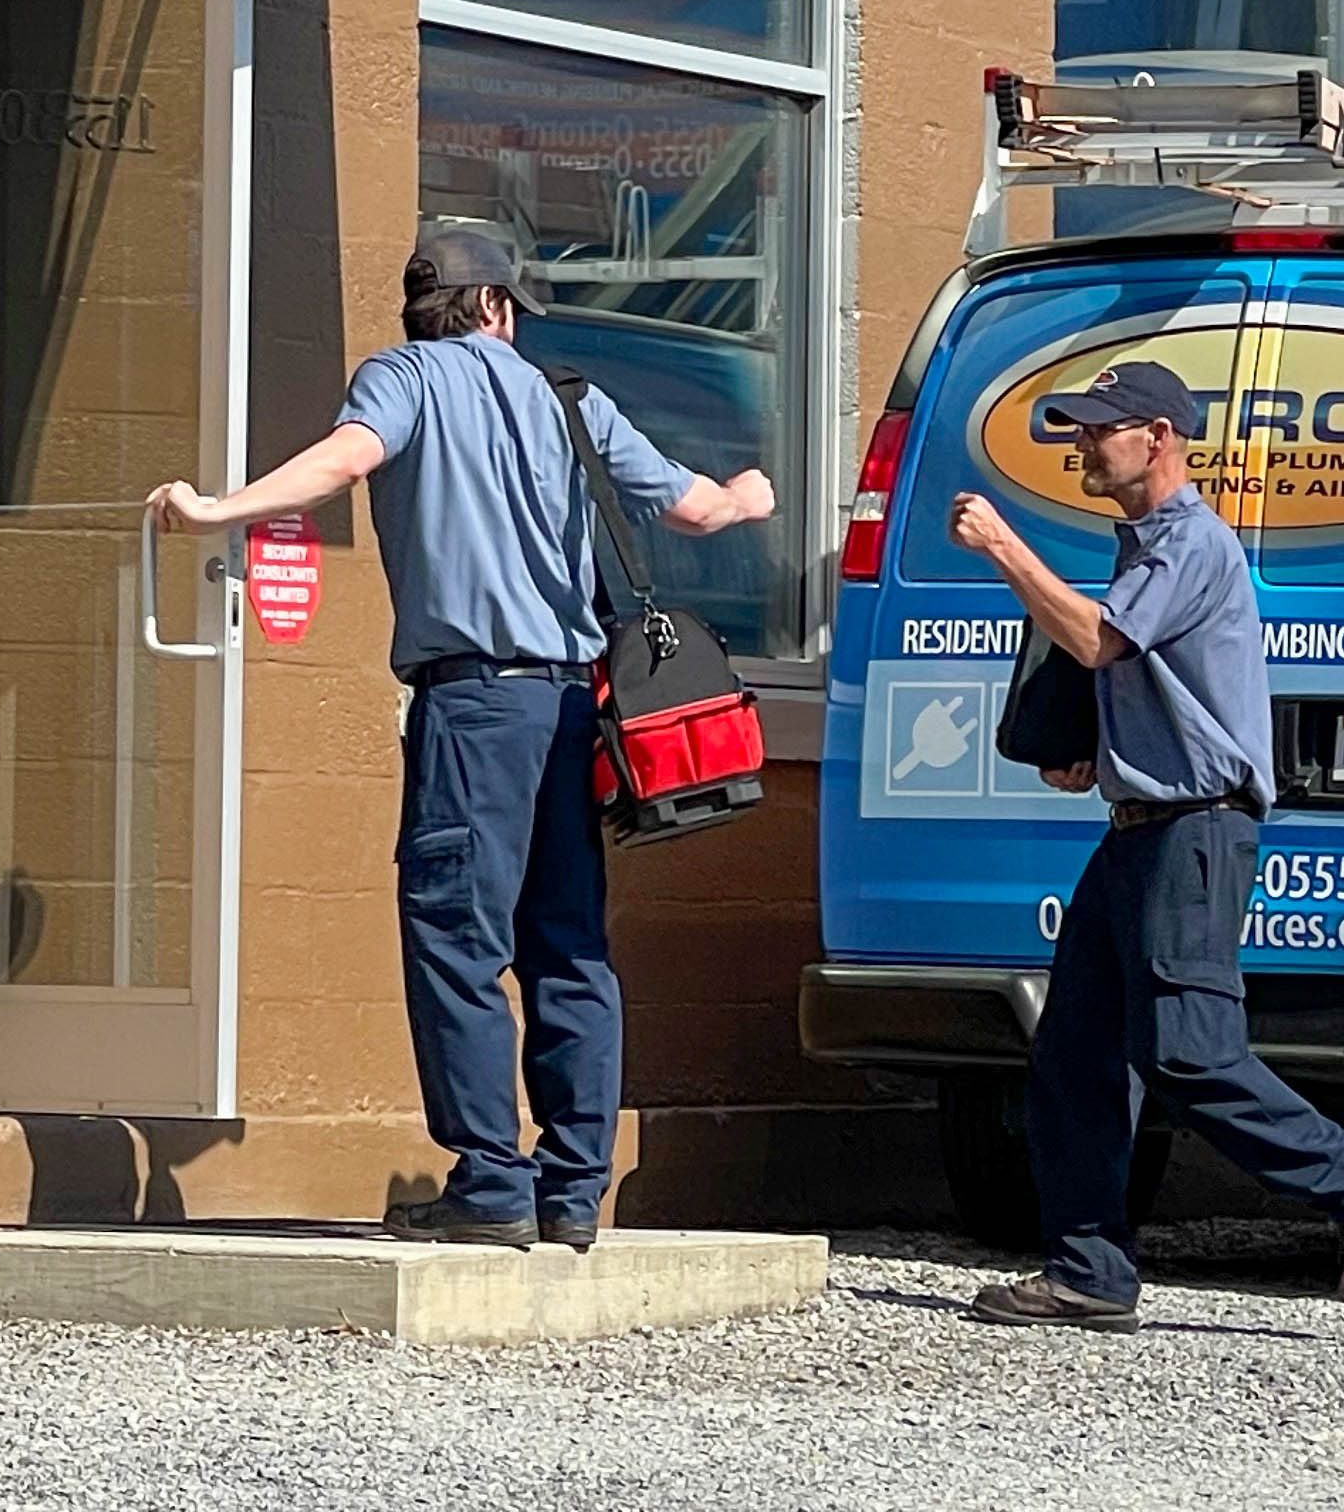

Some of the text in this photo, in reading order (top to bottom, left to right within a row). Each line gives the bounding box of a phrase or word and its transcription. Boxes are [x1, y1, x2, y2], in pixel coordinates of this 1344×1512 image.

[1192, 477, 1263, 496] TING
[1276, 480, 1295, 496] &
[902, 619, 1023, 655] RESIDENTI
